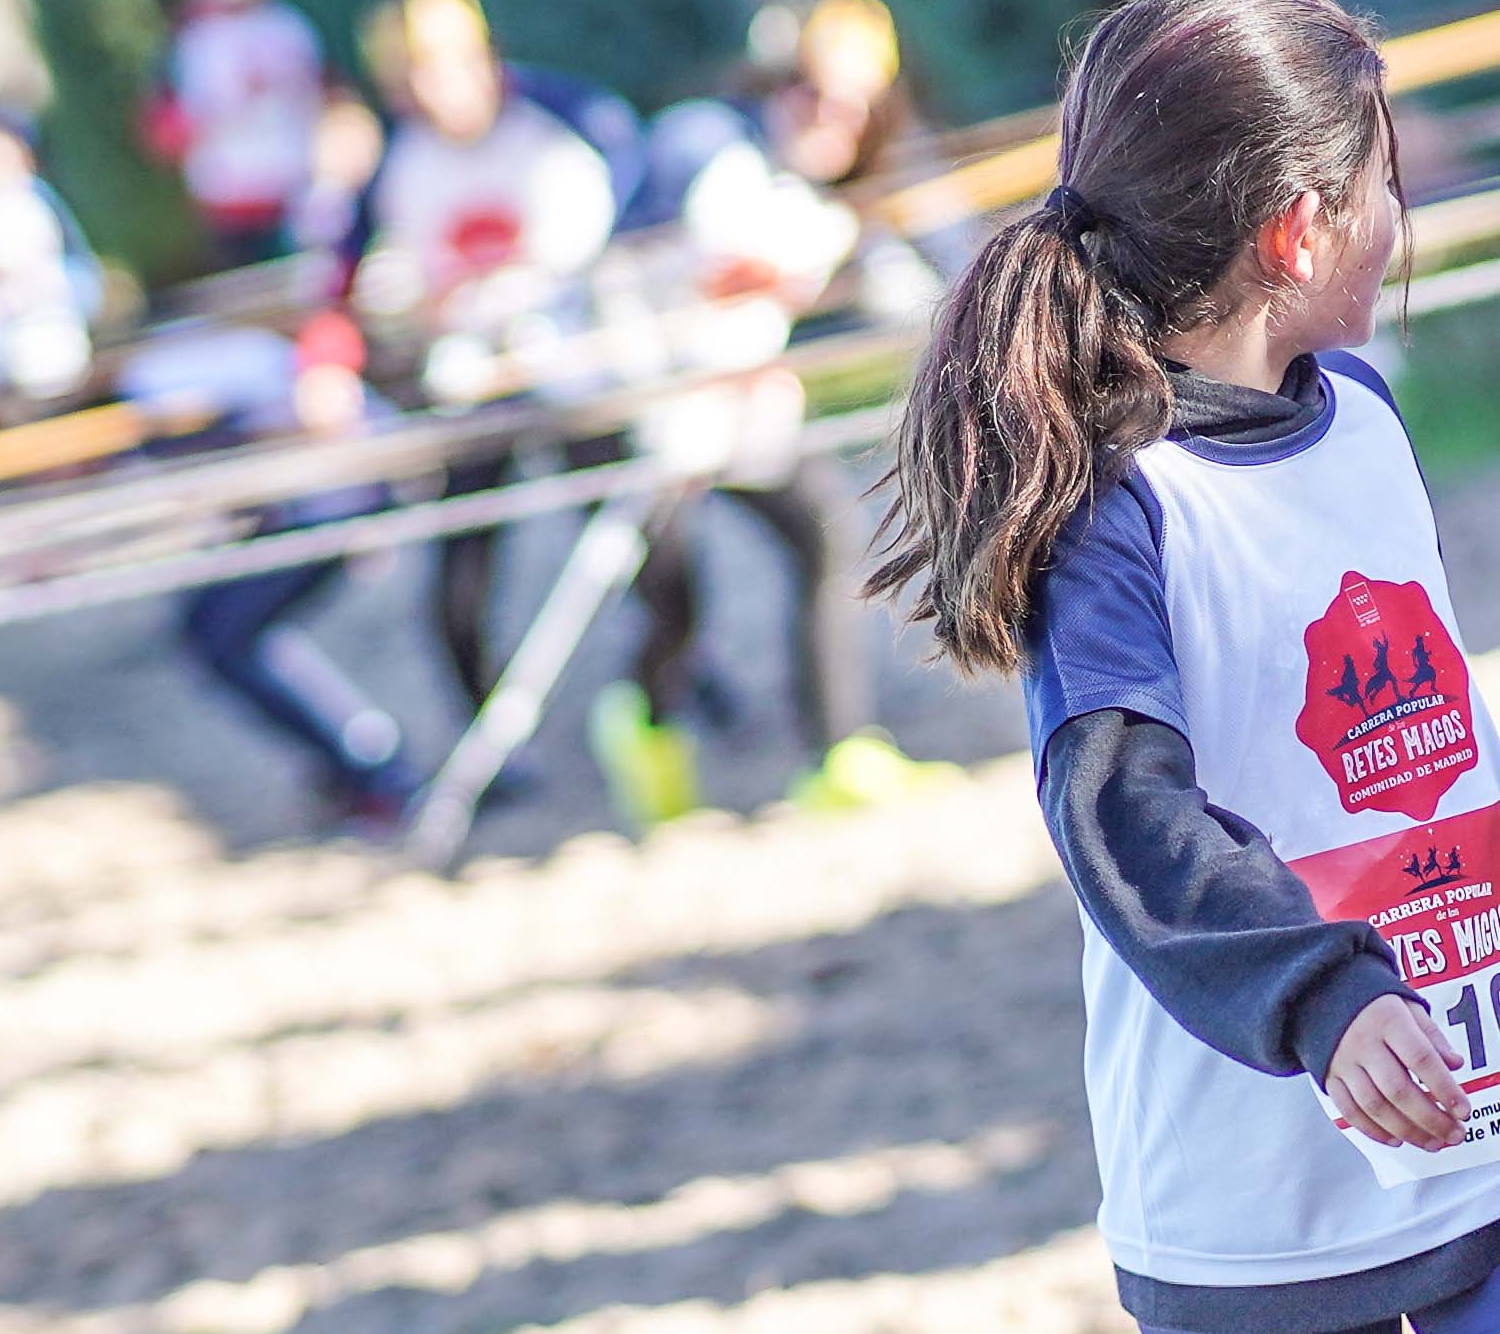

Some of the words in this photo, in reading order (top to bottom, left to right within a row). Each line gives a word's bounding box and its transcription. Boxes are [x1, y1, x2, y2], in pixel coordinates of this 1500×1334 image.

[1347, 709, 1395, 740] CARRERA
[1396, 694, 1445, 717] POPULAR
[1341, 735, 1399, 784] REYES
[1400, 709, 1467, 761] MAGOS
[1349, 770, 1413, 804] COMUNIDAD
[1416, 763, 1433, 778] DE
[1434, 748, 1474, 772] MADRID
[1368, 893, 1445, 929] CARRERA
[1444, 881, 1493, 905] POPULAR
[1436, 910, 1447, 921] de
[1447, 907, 1460, 918] los
[1386, 928, 1447, 983] YES
[1464, 1126, 1485, 1143] de
